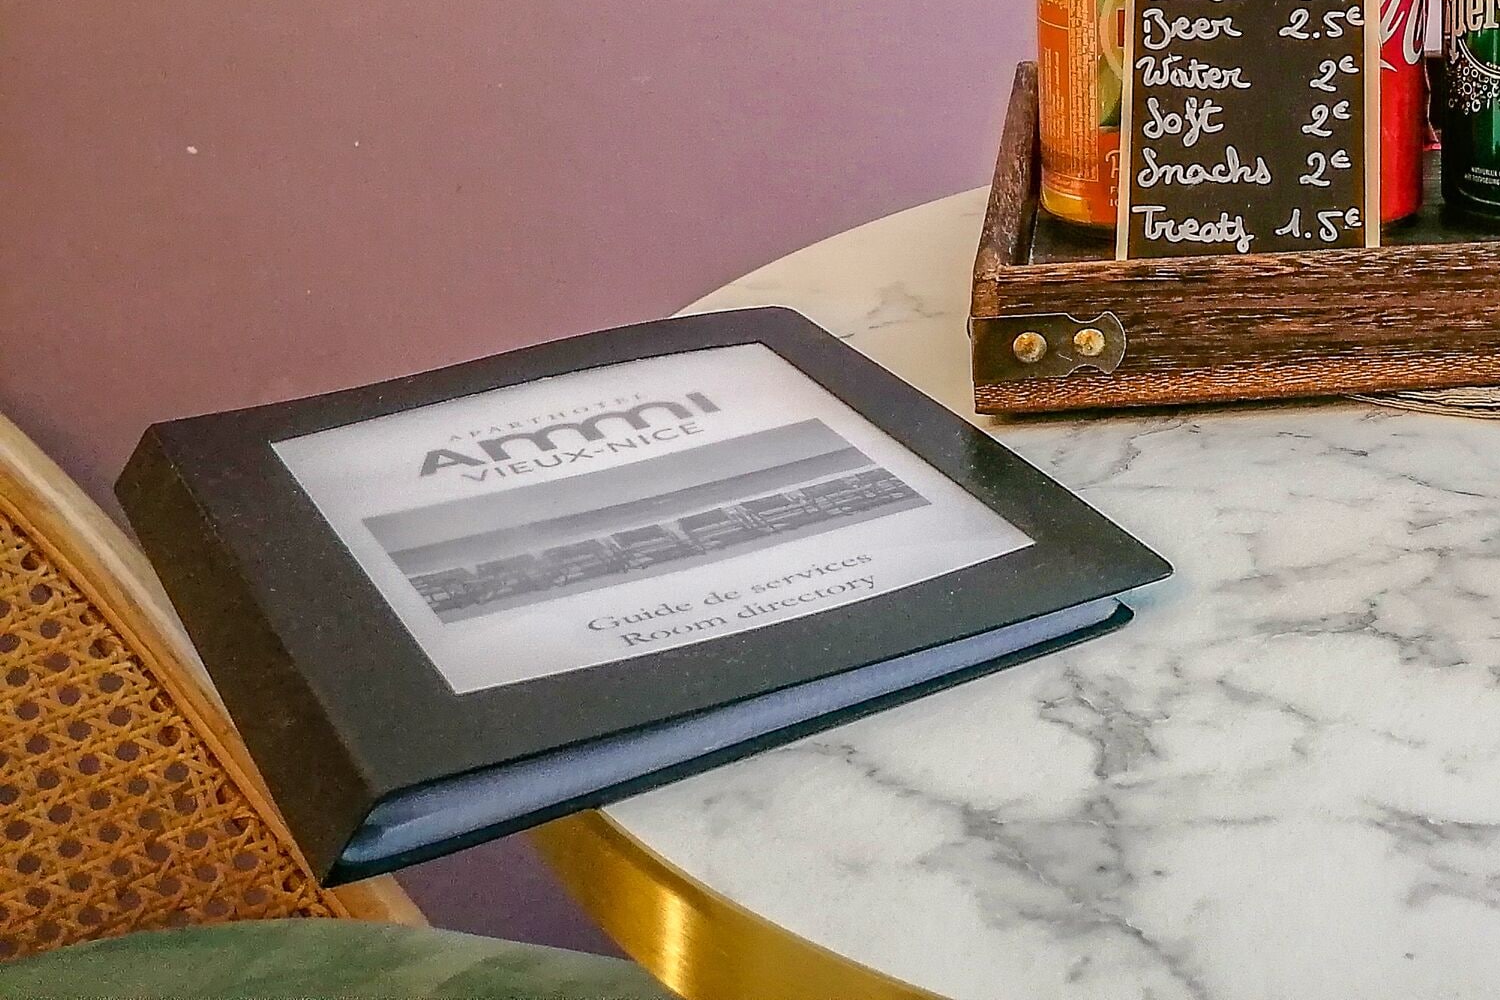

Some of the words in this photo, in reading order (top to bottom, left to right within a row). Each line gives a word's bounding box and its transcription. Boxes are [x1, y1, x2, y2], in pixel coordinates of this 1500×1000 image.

[1142, 7, 1243, 50] Beer
[1278, 5, 1365, 40] 2.5€
[1135, 53, 1252, 91] Water
[1308, 54, 1361, 93] 2€
[1143, 97, 1224, 147] Soft
[1301, 100, 1352, 138] 2€
[1137, 146, 1272, 188] Snacks
[1300, 150, 1352, 187] 2€
[1275, 207, 1362, 242] 1.5€
[461, 421, 704, 483] VIEUX-NICE
[587, 603, 694, 632] Guide
[703, 588, 741, 606] de
[750, 553, 873, 594] services
[618, 614, 728, 647] Room
[736, 574, 876, 620] directory
